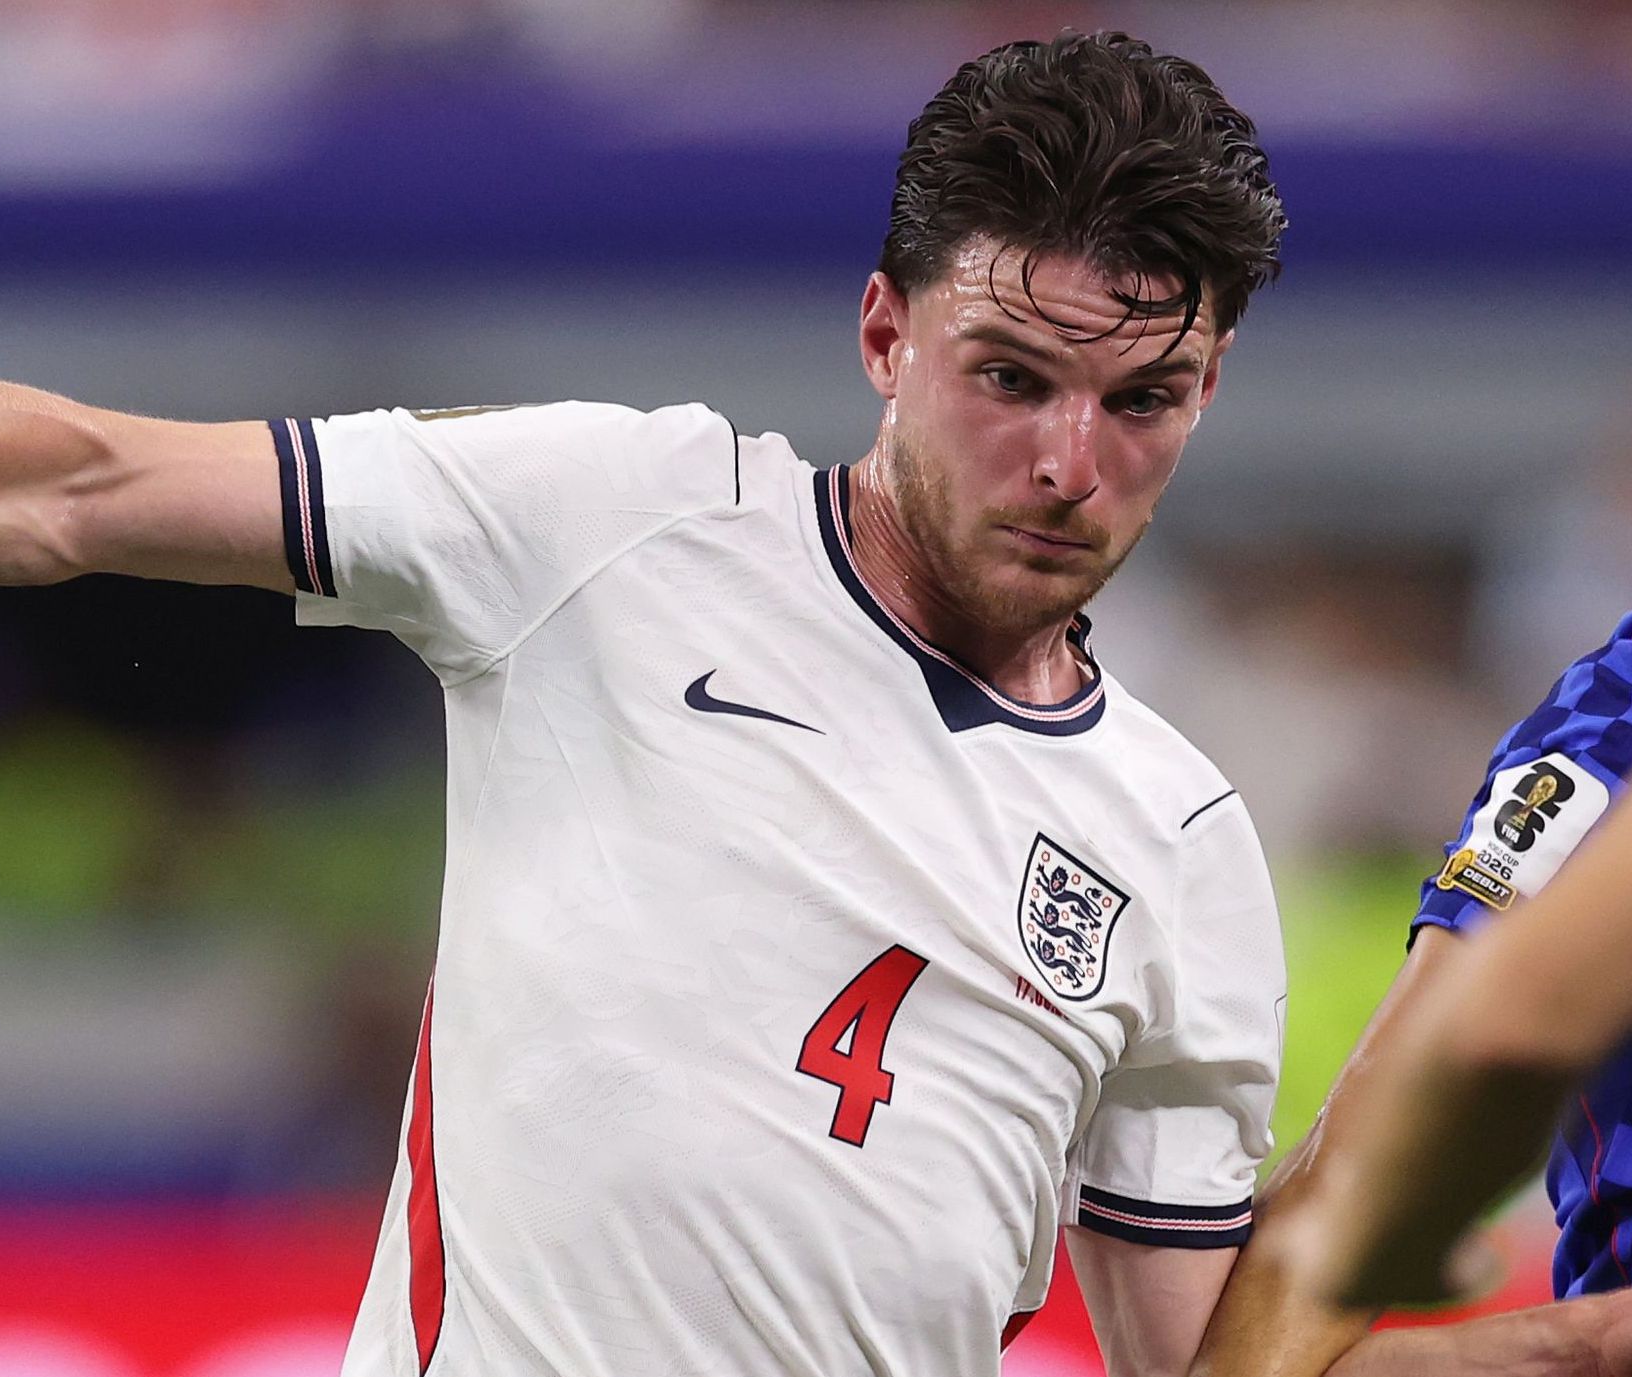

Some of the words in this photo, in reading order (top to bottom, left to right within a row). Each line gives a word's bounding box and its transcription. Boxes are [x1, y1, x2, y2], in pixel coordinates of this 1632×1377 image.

[1501, 824, 1521, 844] FIFA
[1502, 853, 1520, 868] CUP
[1463, 867, 1510, 898] DEBUT
[796, 943, 930, 1149] 4
